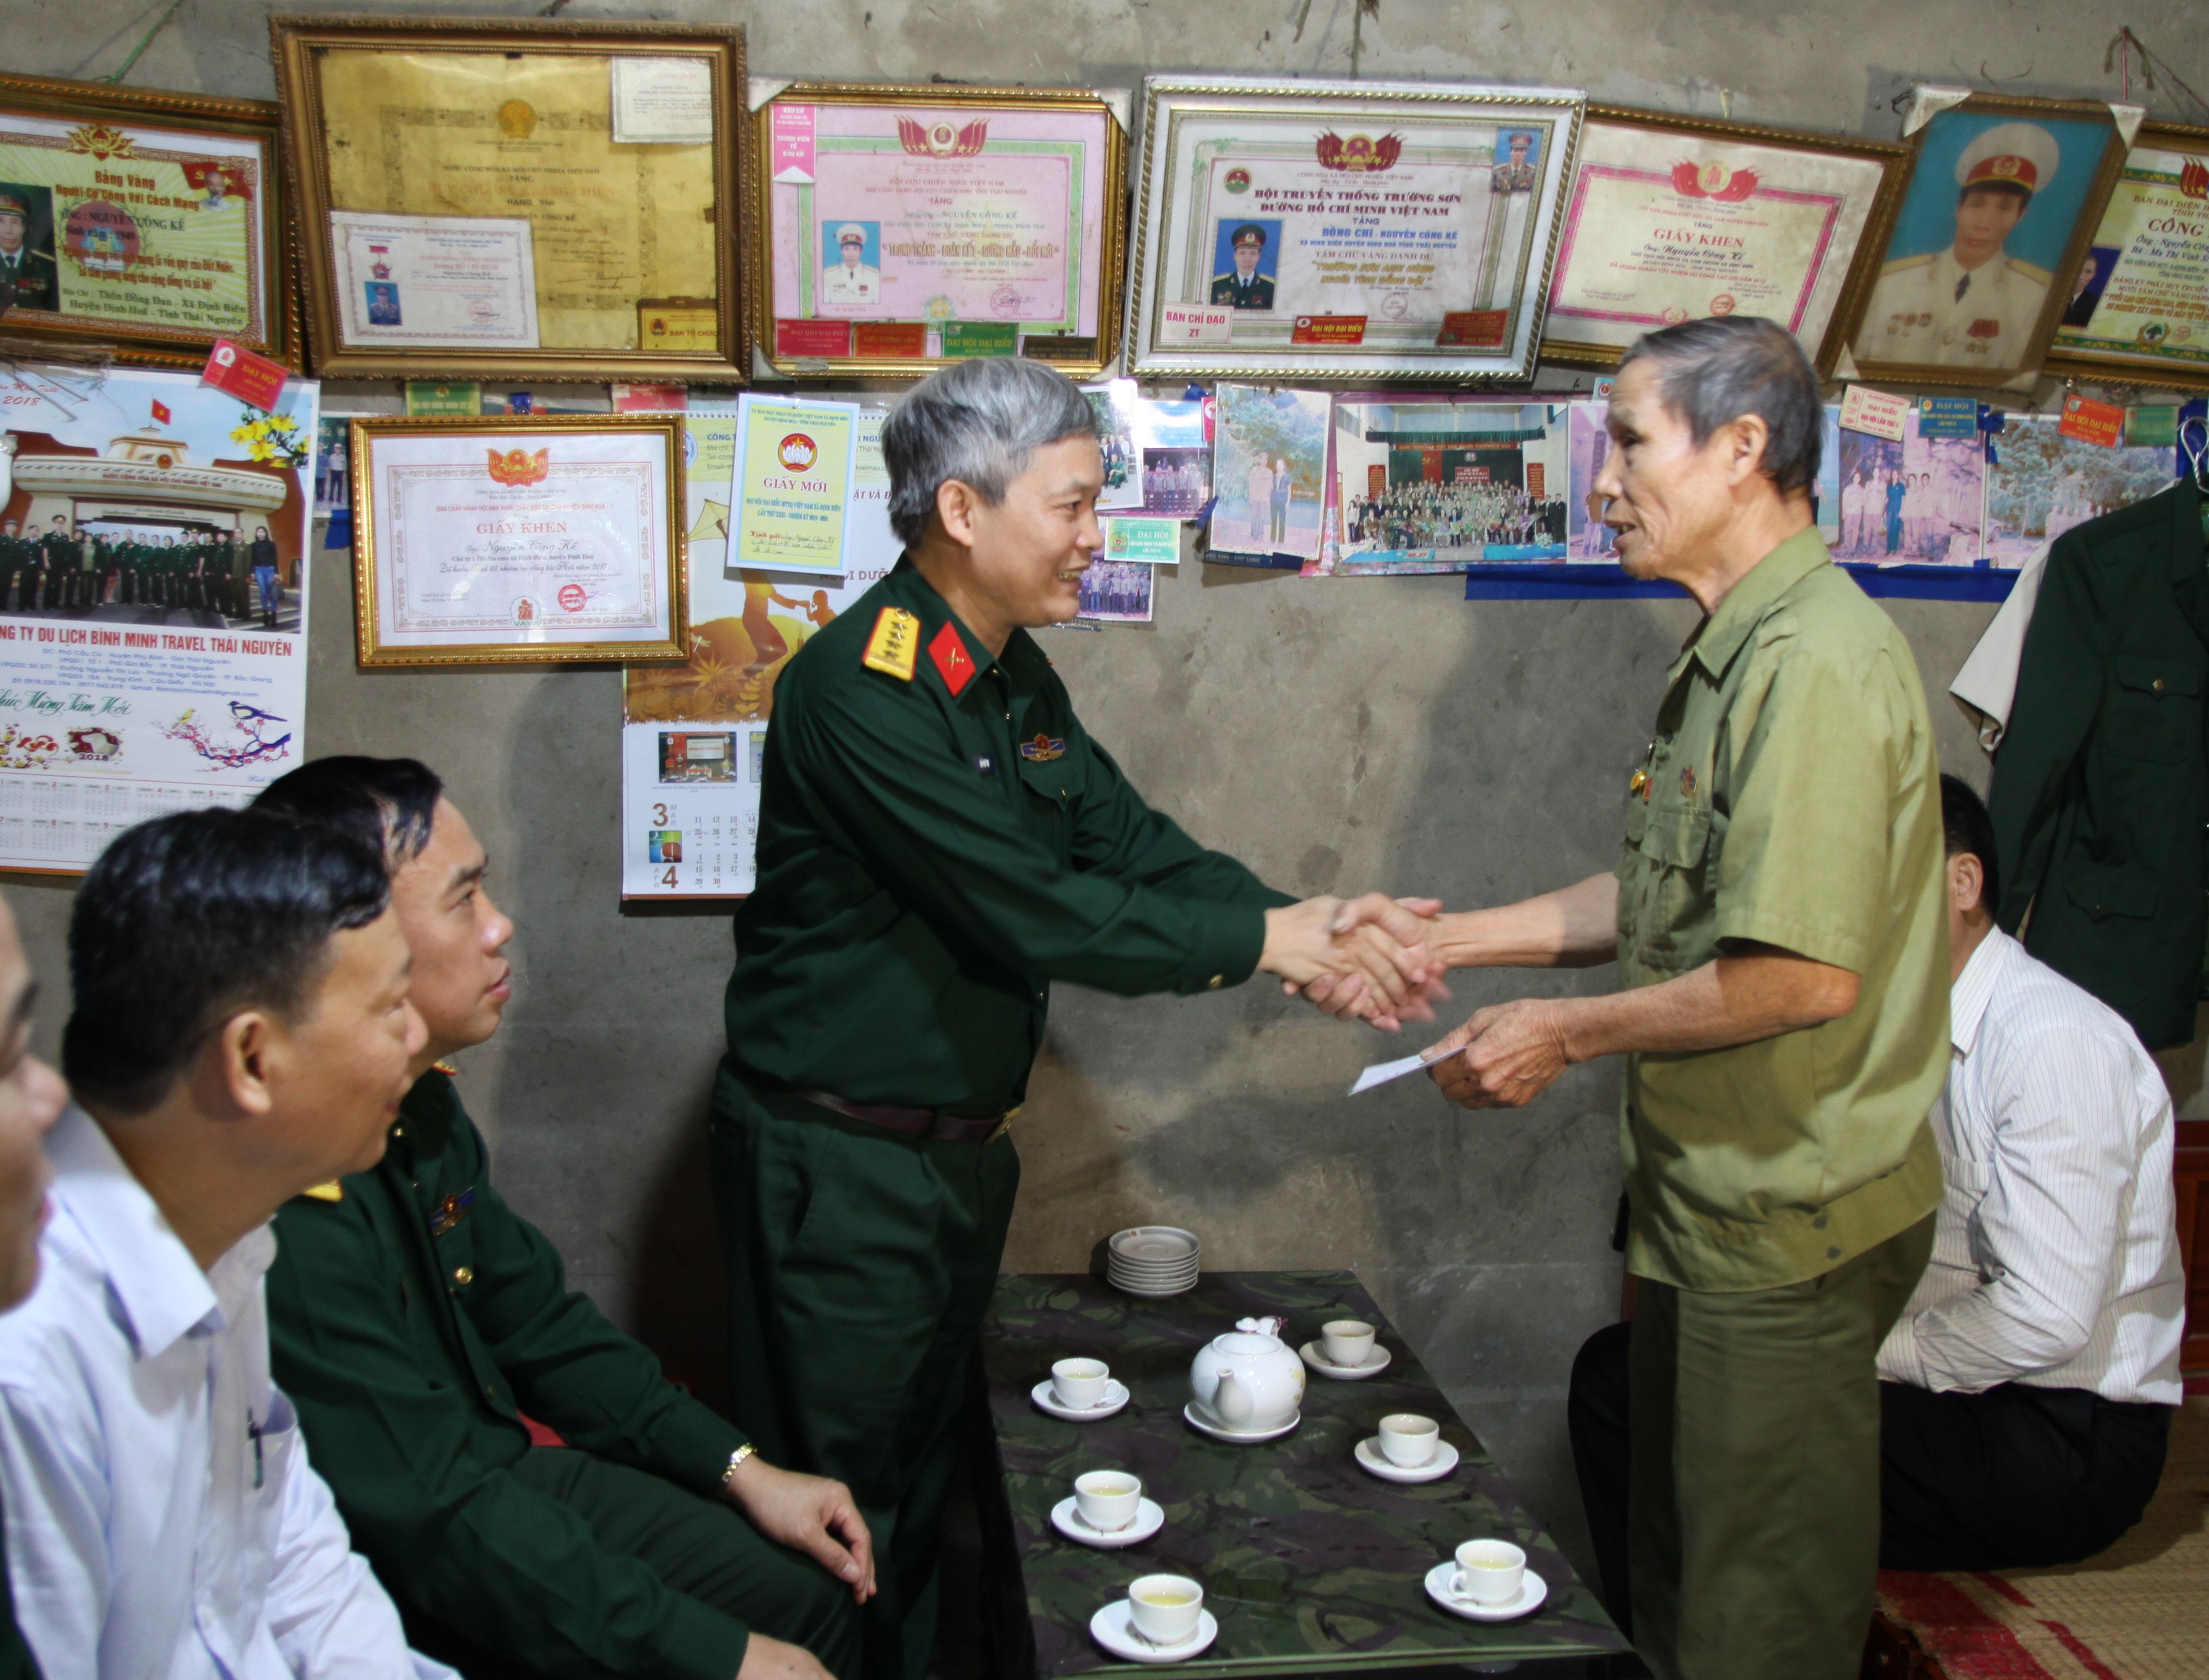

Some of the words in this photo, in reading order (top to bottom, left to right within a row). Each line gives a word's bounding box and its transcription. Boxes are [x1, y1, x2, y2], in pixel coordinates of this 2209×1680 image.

[95, 169, 124, 187] Bảng
[127, 174, 155, 191] Vàng
[889, 178, 903, 186] HỘI
[923, 178, 946, 186] CHIẾN
[970, 178, 985, 188] VIỆT
[56, 184, 83, 199] Người
[147, 193, 171, 206] Cách
[173, 196, 199, 211] Mạng
[929, 196, 953, 206] TẶNG
[1255, 189, 1279, 201] HỘI
[1282, 188, 1333, 201] TRUYỀN
[1337, 189, 1379, 202] THỐNG
[1384, 192, 1434, 203] TRƯỜNG
[1438, 193, 1462, 203] SƠN
[1307, 202, 1325, 213] HỒ
[1329, 203, 1351, 214] CHÍ
[1353, 205, 1387, 215] MINH
[1390, 205, 1420, 218] VIỆT
[1422, 206, 1450, 216] NAM
[2133, 196, 2154, 205] BAN
[2156, 199, 2174, 208] ĐẠI
[2176, 199, 2200, 210] DIỆN
[941, 210, 976, 219] NGUYỄN
[979, 210, 1003, 220] CÔNG
[1006, 211, 1018, 220] KẾ
[1352, 217, 1380, 227] TẶNG
[1322, 225, 1351, 238] ĐỒNG
[1354, 227, 1374, 238] CHÍ
[1380, 228, 1416, 239] NGUYỄN
[1419, 229, 1443, 239] CÔNG
[1445, 230, 1459, 240] KẾ
[2148, 218, 2204, 236] CÔNG
[1653, 227, 1696, 243] GIẤY
[1698, 234, 1746, 248] KHEN
[1316, 249, 1336, 258] TÁM
[1339, 251, 1359, 259] CHỮ
[1362, 251, 1387, 259] VÀNG
[1663, 245, 1699, 258] Nguyễn
[99, 289, 122, 300] Thôn
[125, 292, 150, 305] Đồng
[181, 297, 195, 307] Xã
[198, 299, 222, 311] Định
[223, 302, 246, 312] Biên
[70, 300, 101, 313] Huyện
[103, 303, 126, 315] Định
[158, 309, 179, 319] Tỉnh
[182, 310, 203, 320] Thái
[206, 312, 243, 325] Nguyên
[1166, 311, 1186, 323] BAN
[1187, 311, 1204, 323] CHỈ
[1206, 315, 1226, 326] ĐẠO
[1188, 329, 1200, 338] ZT
[1311, 325, 1323, 333] ĐẠI
[1323, 324, 1335, 333] HỘI
[1335, 325, 1347, 333] ĐẠI
[1347, 323, 1363, 333] BIỂU
[947, 338, 961, 348] ĐẠI
[963, 337, 977, 348] HỘI
[979, 338, 993, 348] ĐẠI
[995, 336, 1012, 348] BIỂU
[2, 395, 42, 406] 2018
[2063, 412, 2077, 422] ĐẠI
[707, 433, 731, 441] CÔNG
[763, 476, 797, 490] GIẤY
[800, 479, 828, 493] MỜI
[869, 489, 881, 500] VÀ
[476, 519, 516, 535] GIẤY
[521, 520, 568, 533] KHEN
[1137, 531, 1152, 539] ĐẠI
[1154, 530, 1169, 540] HỘI
[483, 539, 525, 555] Nguyễn
[528, 539, 555, 554] Công
[592, 563, 608, 571] 2017
[20, 626, 34, 642] TY
[38, 627, 55, 643] DU
[59, 628, 87, 647] LỊCH
[91, 627, 121, 647] BÌNH
[125, 632, 158, 649] MINH
[162, 634, 206, 652] TRAVEL
[211, 636, 238, 654] THÁI
[242, 638, 292, 657] NGUYÊN
[24, 690, 66, 717] Mừng
[91, 696, 133, 716] Mới
[79, 753, 111, 761] 2018
[653, 803, 668, 827] 3
[662, 865, 679, 889] 4
